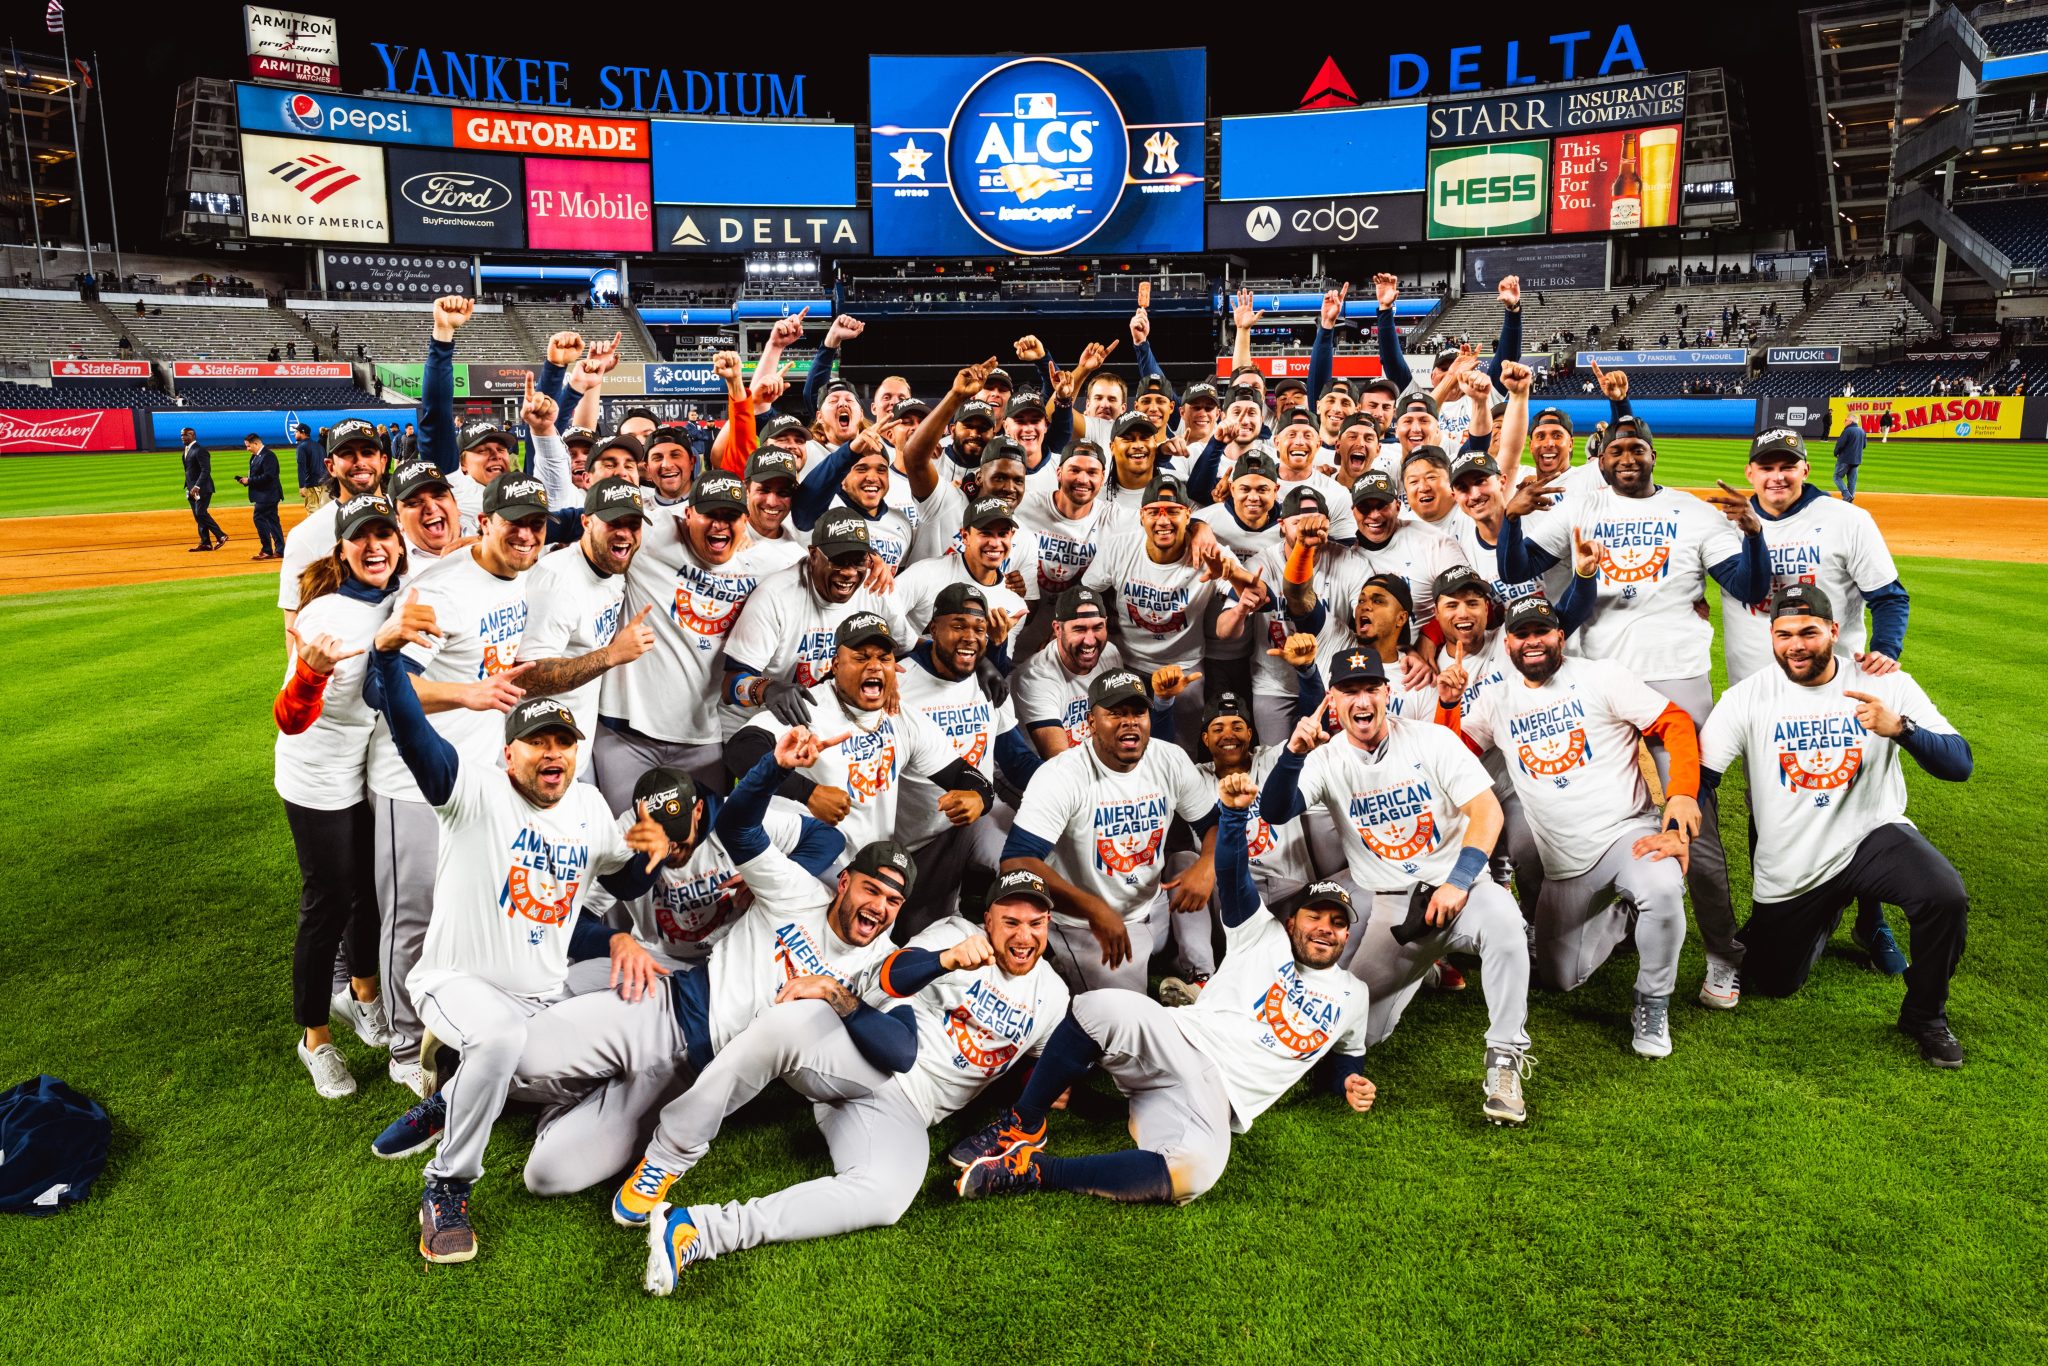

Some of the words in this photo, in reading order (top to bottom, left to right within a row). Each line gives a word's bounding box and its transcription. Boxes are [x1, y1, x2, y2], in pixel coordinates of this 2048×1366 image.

[252, 14, 332, 36] ARMITRON
[260, 58, 330, 77] ARMITRON
[1388, 23, 1646, 100] DELTA
[295, 73, 331, 84] WATCHES
[370, 42, 571, 108] YANKEE
[600, 65, 808, 118] STADIUM
[1568, 80, 1685, 110] INSURANCE
[1430, 99, 1553, 138] STARR
[1567, 97, 1685, 126] COMPANIES
[467, 118, 636, 151] GATORADE
[975, 121, 1093, 164] ALCS
[1560, 142, 1600, 158] This
[1560, 158, 1608, 176] Bud's
[421, 177, 493, 209] Ford
[1440, 173, 1536, 207] HESS
[1560, 177, 1589, 192] For
[531, 190, 553, 216] T
[559, 191, 648, 221] Mobile
[1558, 195, 1596, 211] You.
[251, 212, 292, 225] BANK
[297, 215, 314, 226] OF
[319, 217, 384, 231] AMERICA
[422, 216, 494, 227] BuyFordNow.com
[720, 218, 857, 244] DELTA
[1292, 200, 1379, 242] edge
[369, 268, 385, 277] New
[386, 269, 402, 281] York
[403, 270, 430, 281] Yankees
[1526, 278, 1546, 287] THE
[1550, 276, 1576, 287] BOSS
[1648, 353, 1677, 362] FANDUEL
[1701, 353, 1733, 361] FANDUEL
[382, 373, 420, 388] Uber
[675, 366, 720, 385] coupa
[673, 386, 688, 394] Spend
[1774, 412, 1785, 420] THE
[1846, 401, 1870, 412] WHO
[1872, 401, 1893, 411] BUT
[0, 421, 92, 440] Budweiser
[1594, 521, 1678, 541] AMERICAN
[1602, 536, 1664, 549] LEAGUE
[676, 564, 758, 596] AMERICAN
[1124, 582, 1190, 606] AMERICAN
[1131, 598, 1180, 612] LEAGUE
[1509, 698, 1585, 739] AMERICAN
[1773, 716, 1867, 744] AMERICAN
[1522, 721, 1576, 745] LEAGUE
[1787, 736, 1853, 751] LEAGUE
[1518, 728, 1585, 775] CHAMPIONS
[1778, 748, 1862, 790] CHAMPIONS
[1350, 781, 1432, 819] AMERICAN
[1094, 796, 1166, 829] AMERICAN
[1361, 804, 1423, 827] LEAGUE
[1105, 818, 1159, 838] LEAGUE
[1357, 812, 1433, 860] CHAMPIONS
[1097, 828, 1164, 873] CHAMPIONS
[1000, 873, 1024, 889] World
[965, 979, 1035, 1041] AMERICAN
[1265, 983, 1330, 1053] CHAMPIONS
[970, 1006, 1023, 1046] LEAGUE
